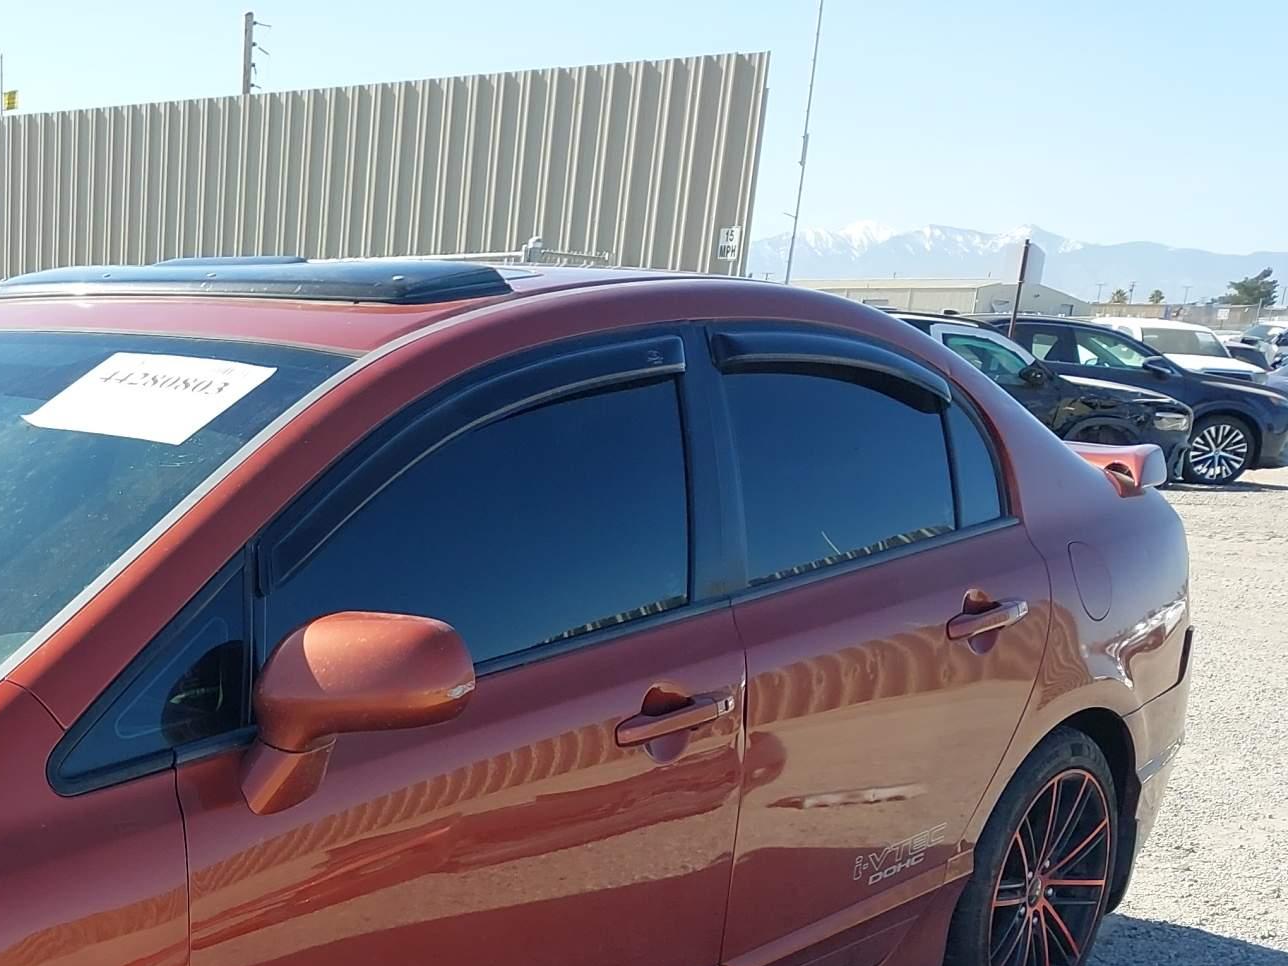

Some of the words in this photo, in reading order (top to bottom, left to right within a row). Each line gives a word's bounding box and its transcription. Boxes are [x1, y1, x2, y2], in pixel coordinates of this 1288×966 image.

[725, 230, 735, 242] 15
[719, 244, 736, 257] MPH
[99, 370, 230, 395] 44280803
[868, 852, 925, 886] DOHC
